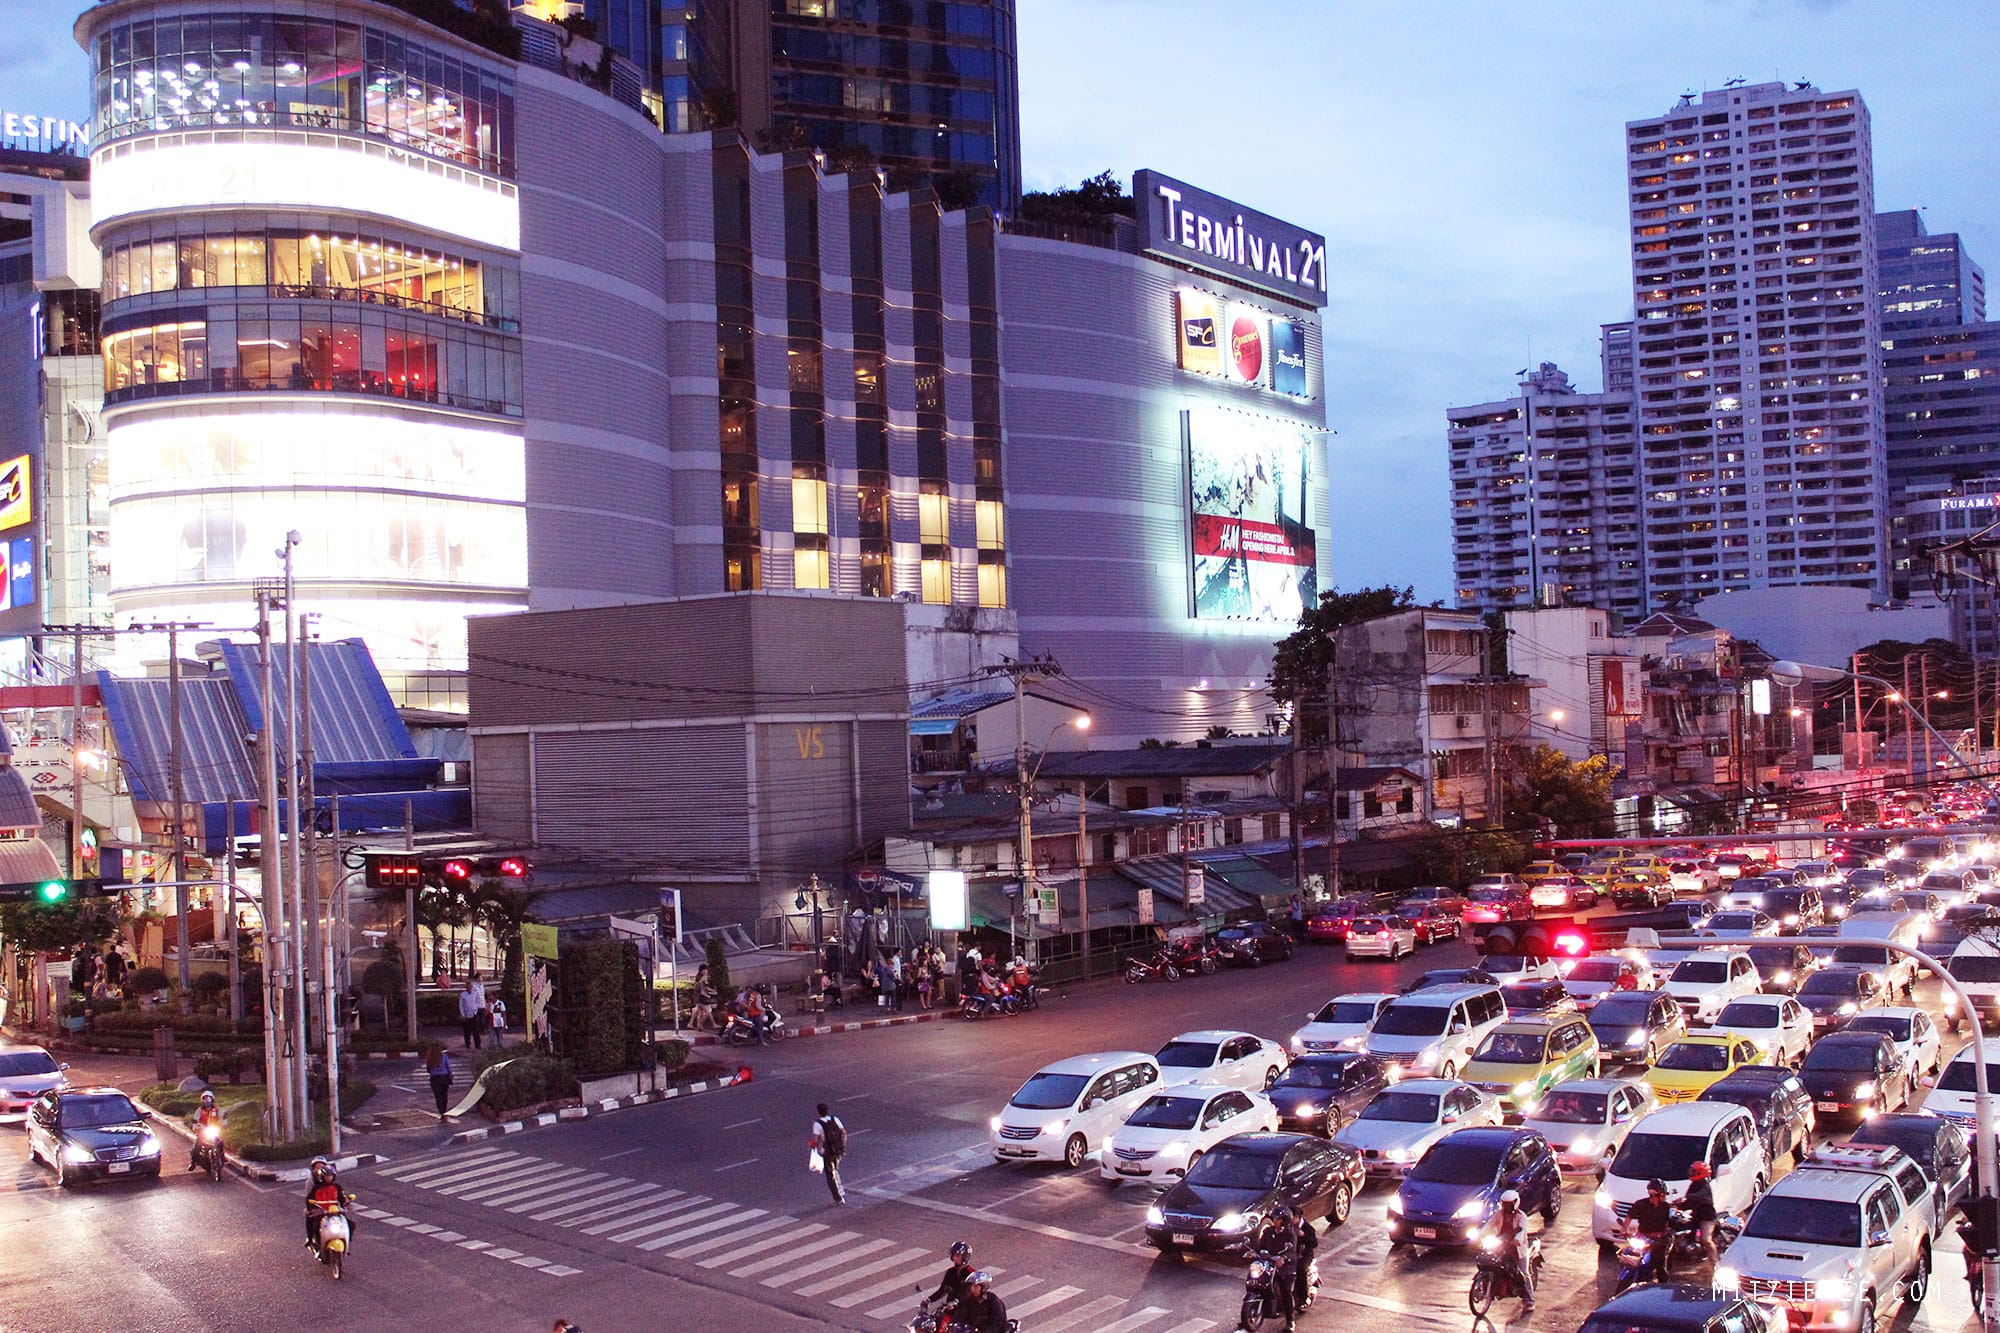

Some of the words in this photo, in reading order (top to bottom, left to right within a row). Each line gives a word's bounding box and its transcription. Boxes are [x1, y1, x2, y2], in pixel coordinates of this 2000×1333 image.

[1300, 239, 1327, 293] 21
[1220, 524, 1240, 552] H&M
[796, 727, 824, 759] VS
